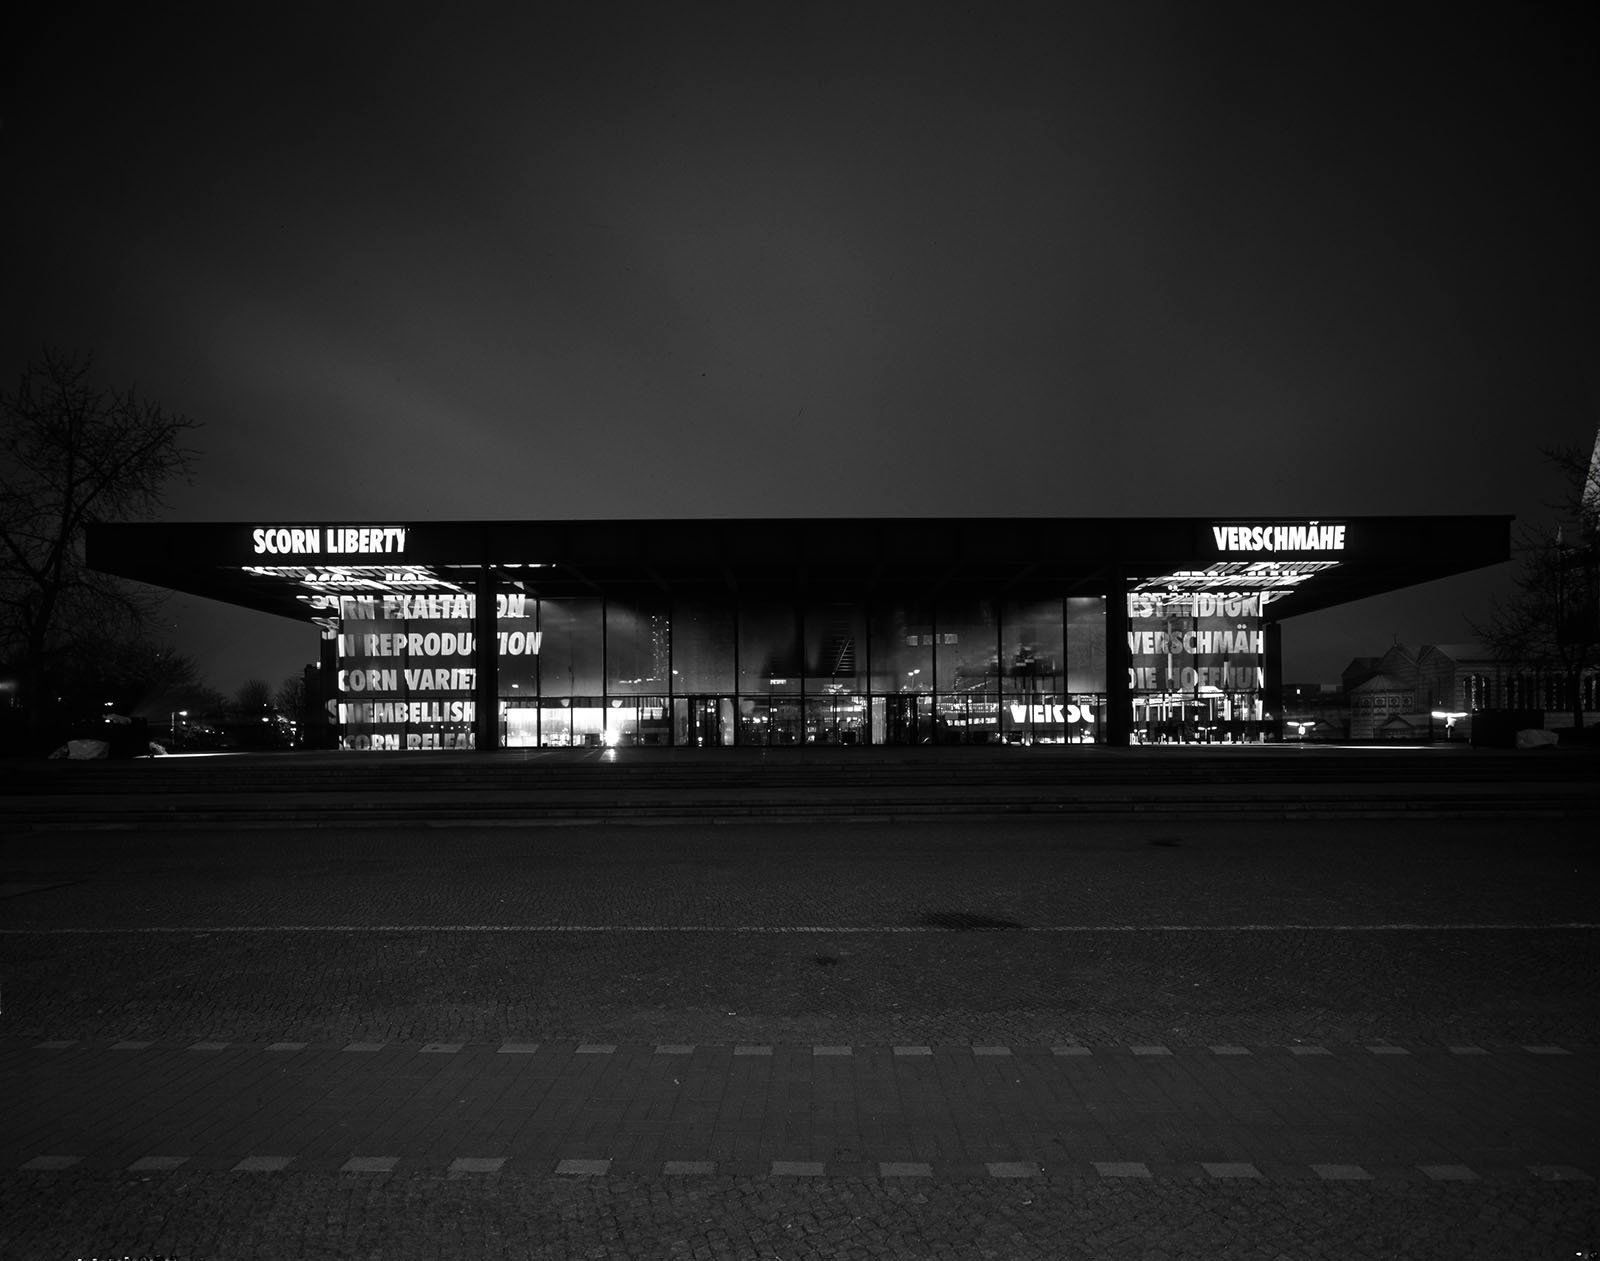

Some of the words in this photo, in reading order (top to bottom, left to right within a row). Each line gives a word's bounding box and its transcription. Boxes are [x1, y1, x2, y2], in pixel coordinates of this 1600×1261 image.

[253, 528, 320, 553] SCORN
[327, 528, 405, 553] LIBERTY
[1213, 521, 1345, 551] VERSCHMÄHE
